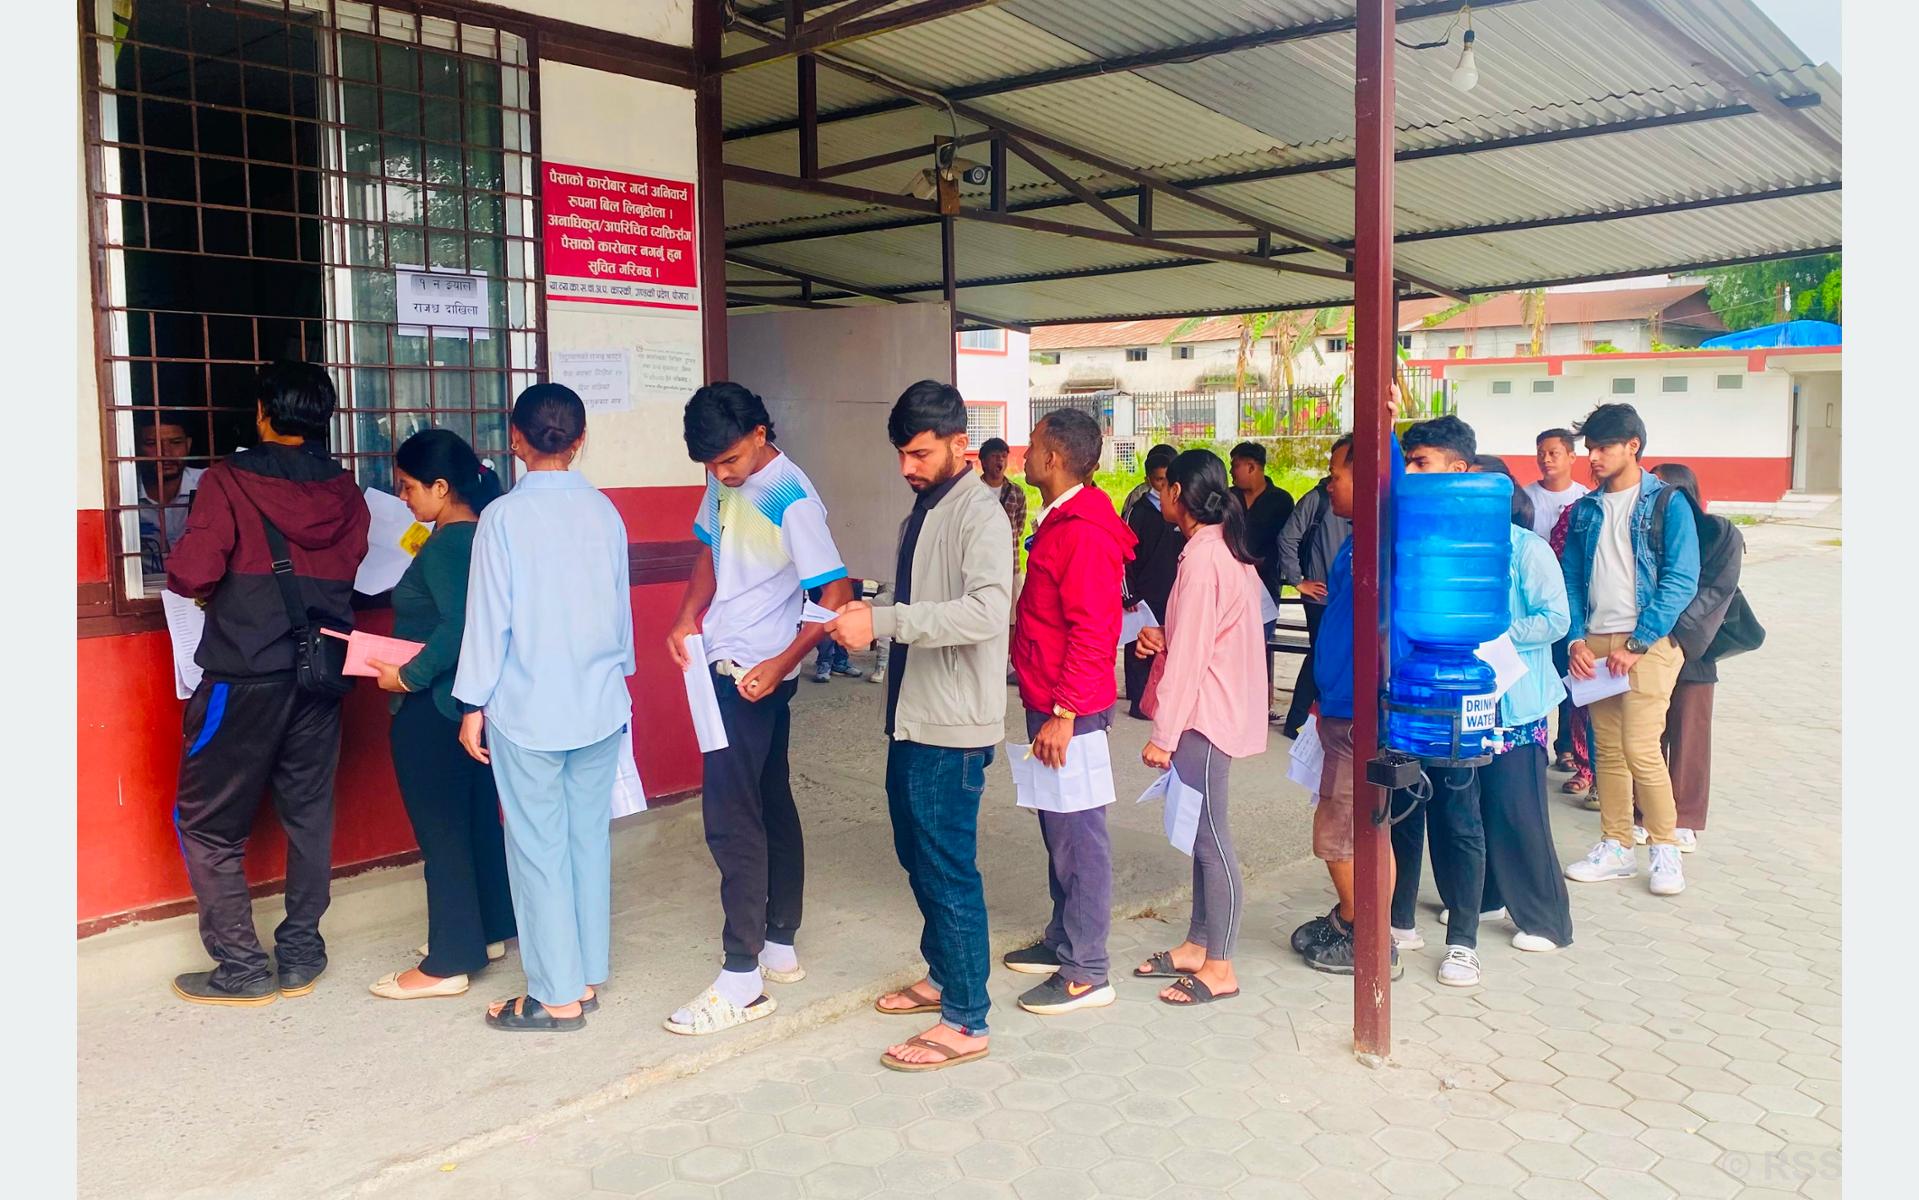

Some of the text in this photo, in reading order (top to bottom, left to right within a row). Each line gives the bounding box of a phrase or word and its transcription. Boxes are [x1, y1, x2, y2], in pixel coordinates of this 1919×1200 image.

[549, 168, 583, 187] पैसाको
[586, 176, 627, 193] कारोबार
[599, 196, 620, 212] बिल
[623, 199, 666, 219] लिनुहोला
[560, 234, 595, 251] पैसाको
[597, 240, 638, 256] कारोबार
[666, 248, 682, 262] हुन
[588, 258, 616, 275] सुचित
[619, 261, 652, 277] गरिन्छ
[445, 300, 479, 315] दाखिला
